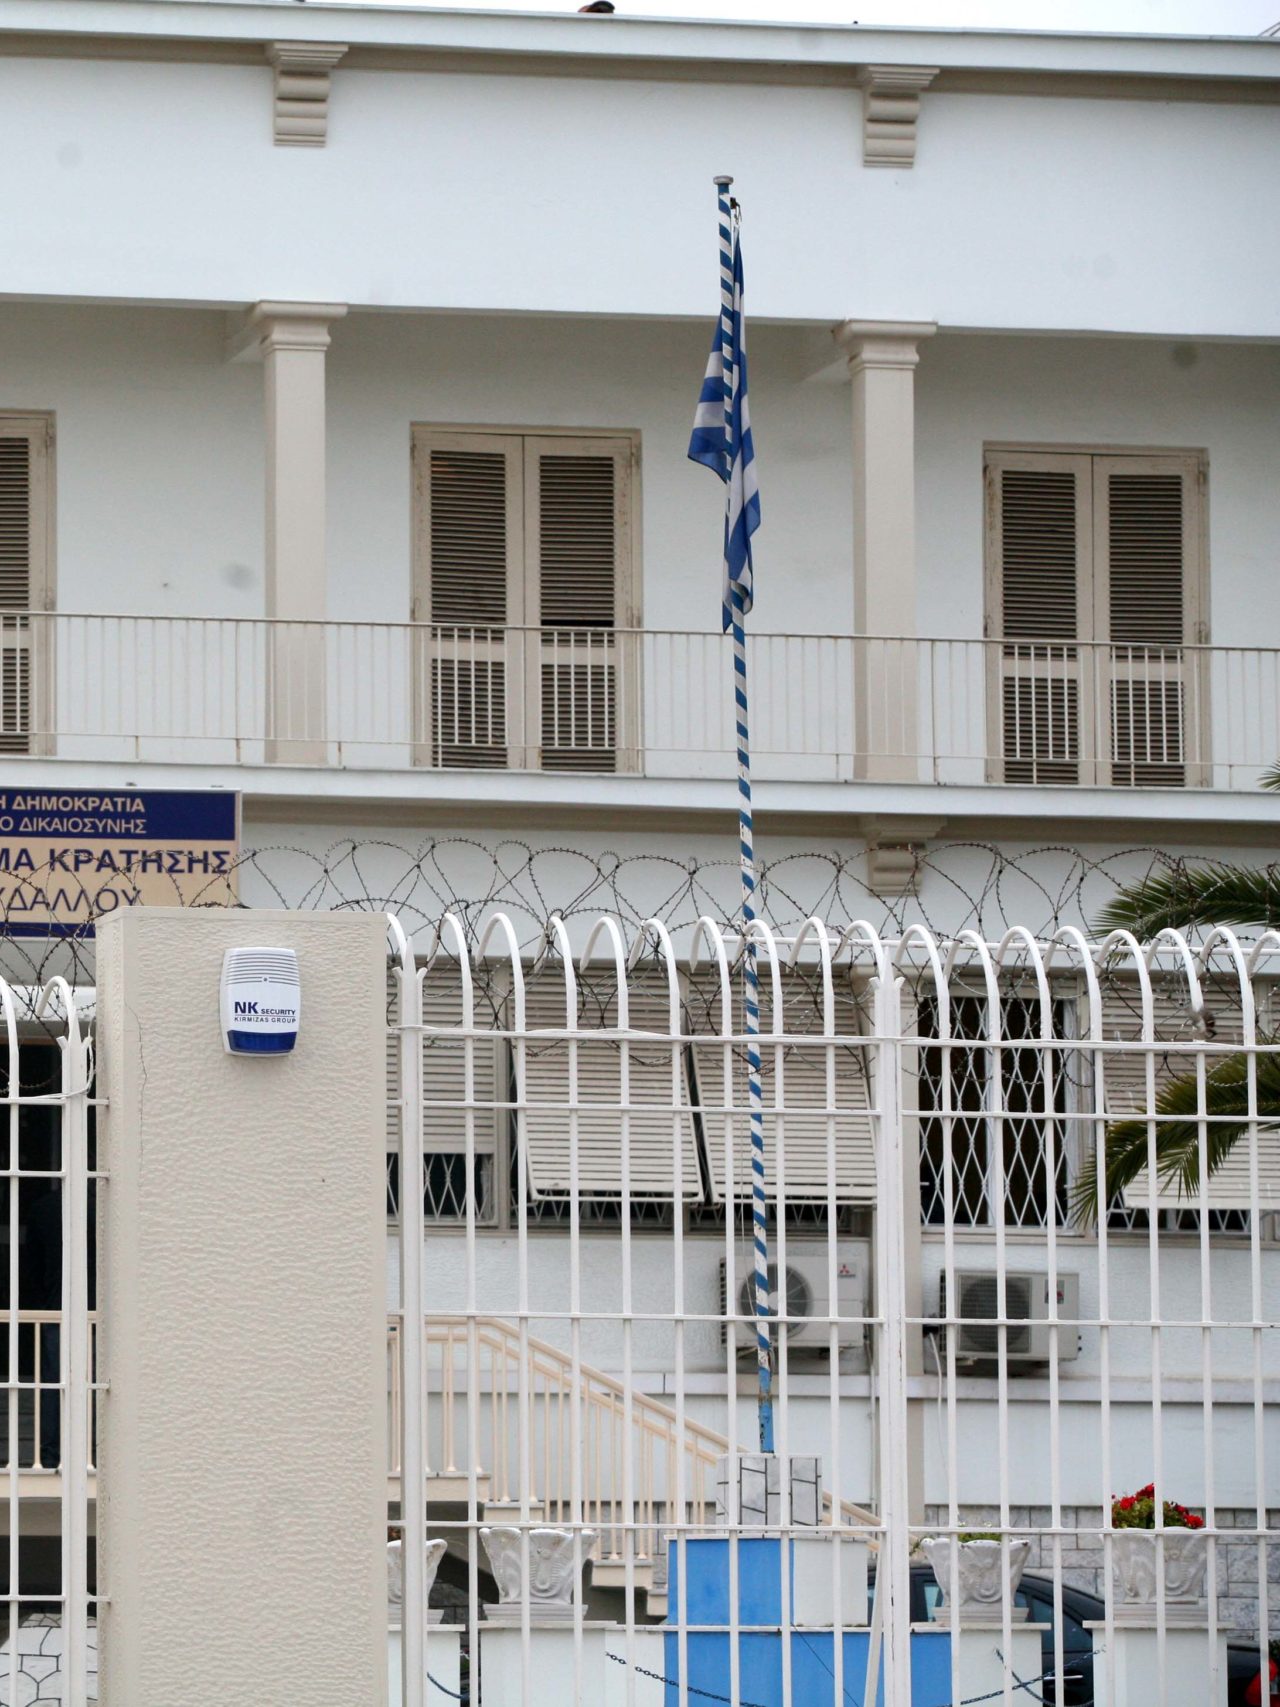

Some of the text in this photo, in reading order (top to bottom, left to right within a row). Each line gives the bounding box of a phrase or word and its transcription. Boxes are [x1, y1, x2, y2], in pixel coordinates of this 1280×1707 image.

[12, 796, 145, 813] ΔΗΜΟΚΡΑΤΙΑ
[19, 816, 147, 834] ΔΙΚΑΙΟΣΥΝΗΣ
[49, 848, 231, 875] ΚΡΑΤΗΣΗΣ
[234, 1001, 258, 1014] NK
